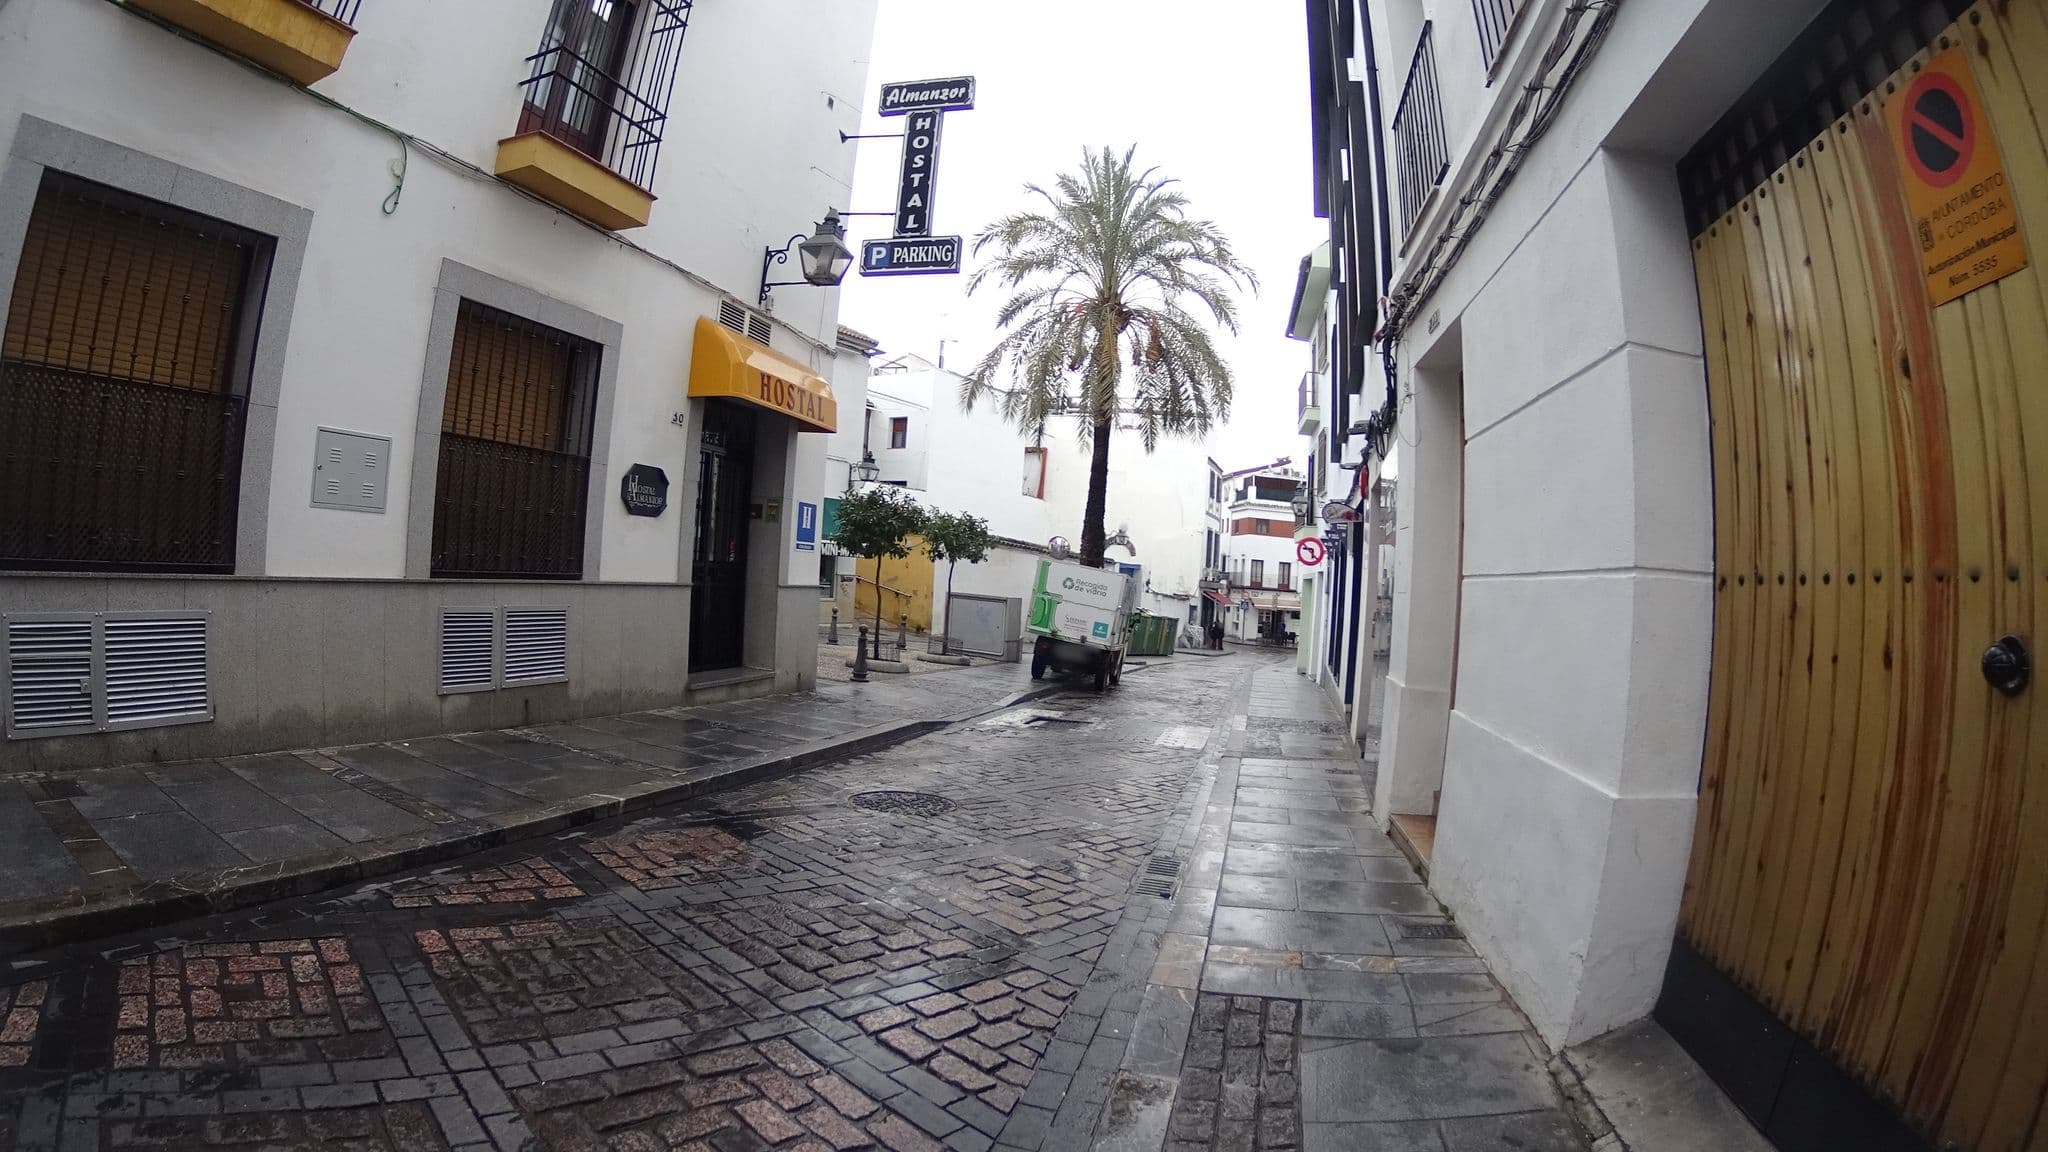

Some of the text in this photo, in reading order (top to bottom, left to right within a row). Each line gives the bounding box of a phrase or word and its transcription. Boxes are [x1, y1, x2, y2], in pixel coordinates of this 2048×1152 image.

[886, 86, 966, 106] Almanzor
[906, 117, 932, 228] HOSTAL
[871, 244, 952, 266] P PARKING
[760, 373, 824, 422] HOSTAL
[1075, 578, 1108, 592] Recogida
[1085, 587, 1107, 598] vidrio
